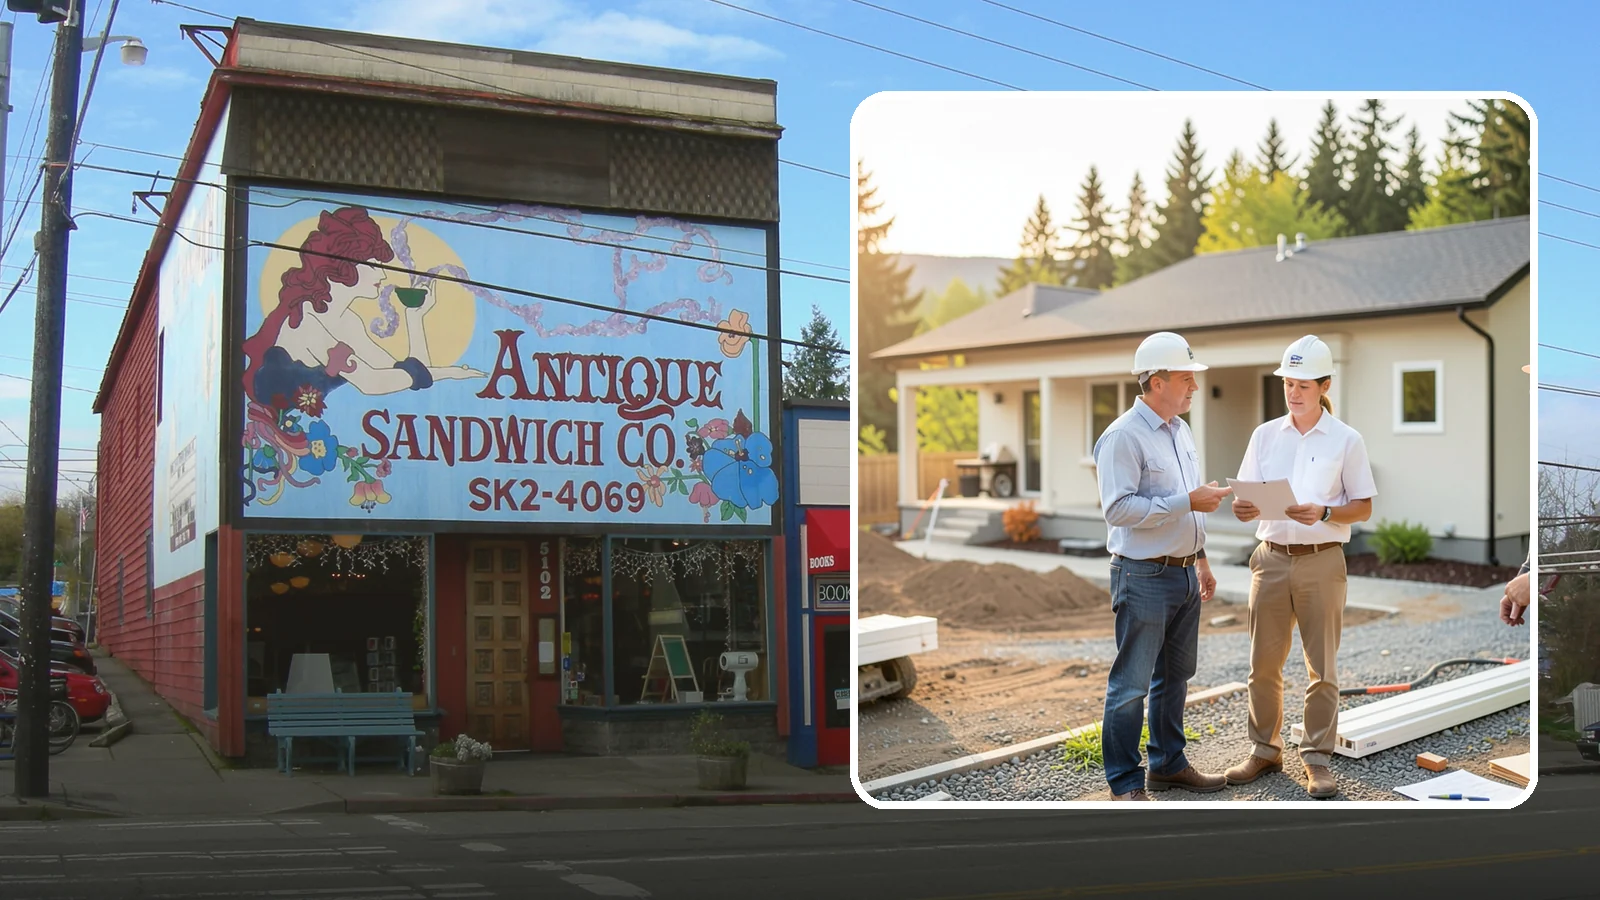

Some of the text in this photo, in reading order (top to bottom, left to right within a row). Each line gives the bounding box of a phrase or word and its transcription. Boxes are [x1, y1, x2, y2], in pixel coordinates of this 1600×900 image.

[475, 329, 723, 420] ANTIQUE
[361, 408, 685, 469] SANDWICH CO.
[468, 477, 646, 513] SK2-4069
[540, 542, 551, 599] 5102
[809, 555, 835, 569] BOOKS
